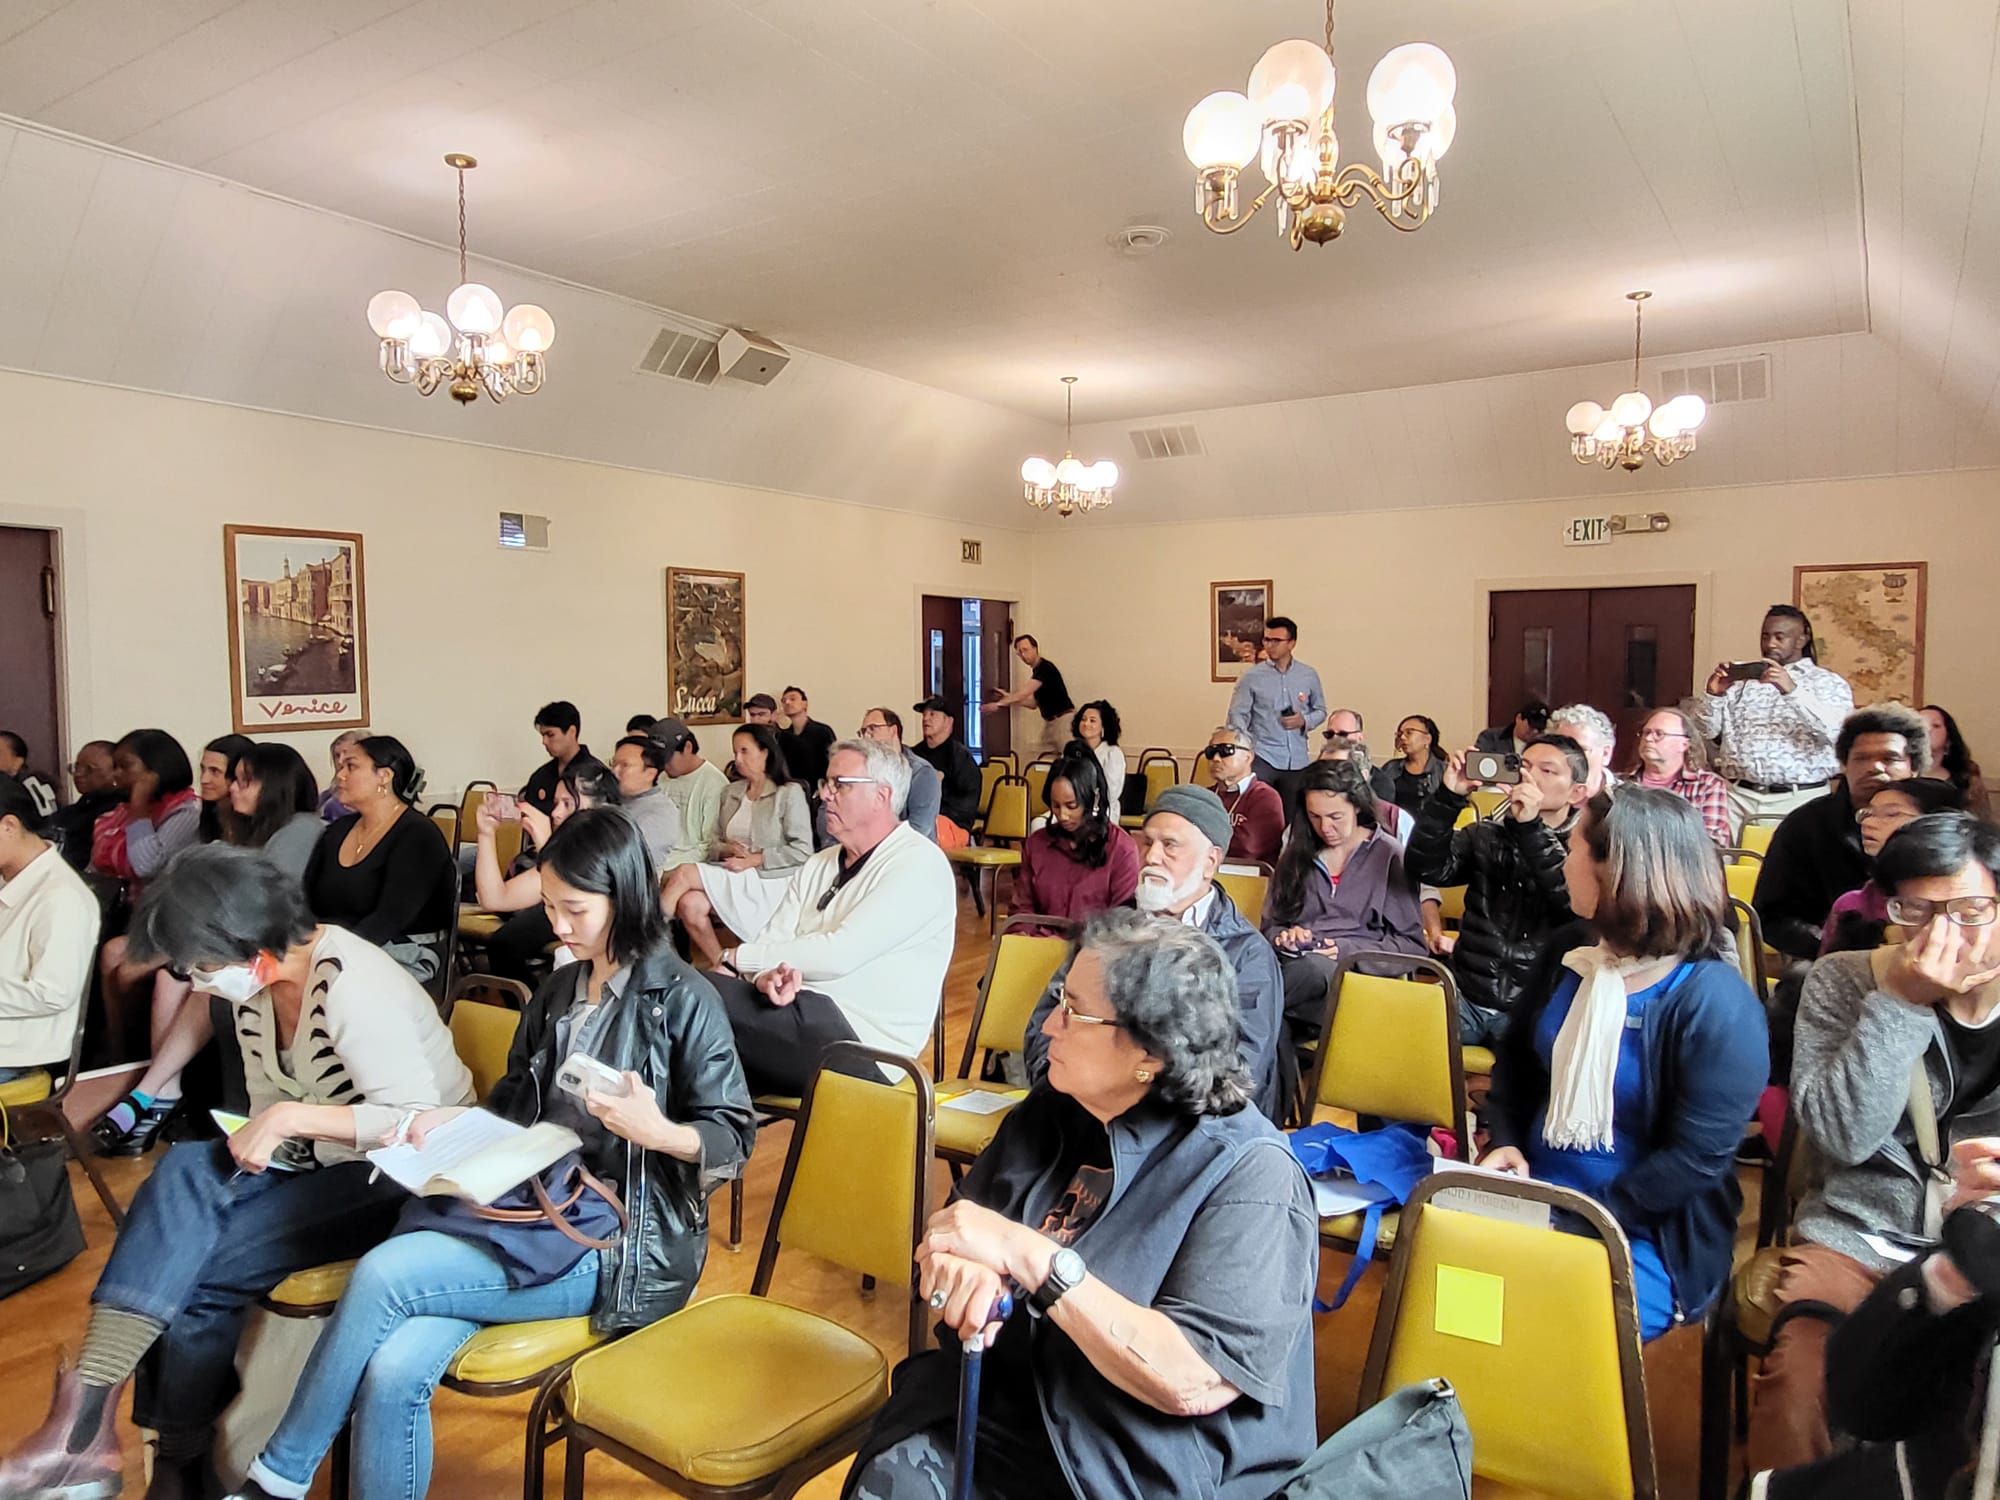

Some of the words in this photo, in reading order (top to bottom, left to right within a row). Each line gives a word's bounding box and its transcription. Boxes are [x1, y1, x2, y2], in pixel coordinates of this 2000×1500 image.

[1573, 518, 1605, 541] EXIT
[962, 541, 981, 561] EXIT
[259, 698, 348, 719] Venice
[673, 686, 716, 714] Lucca
